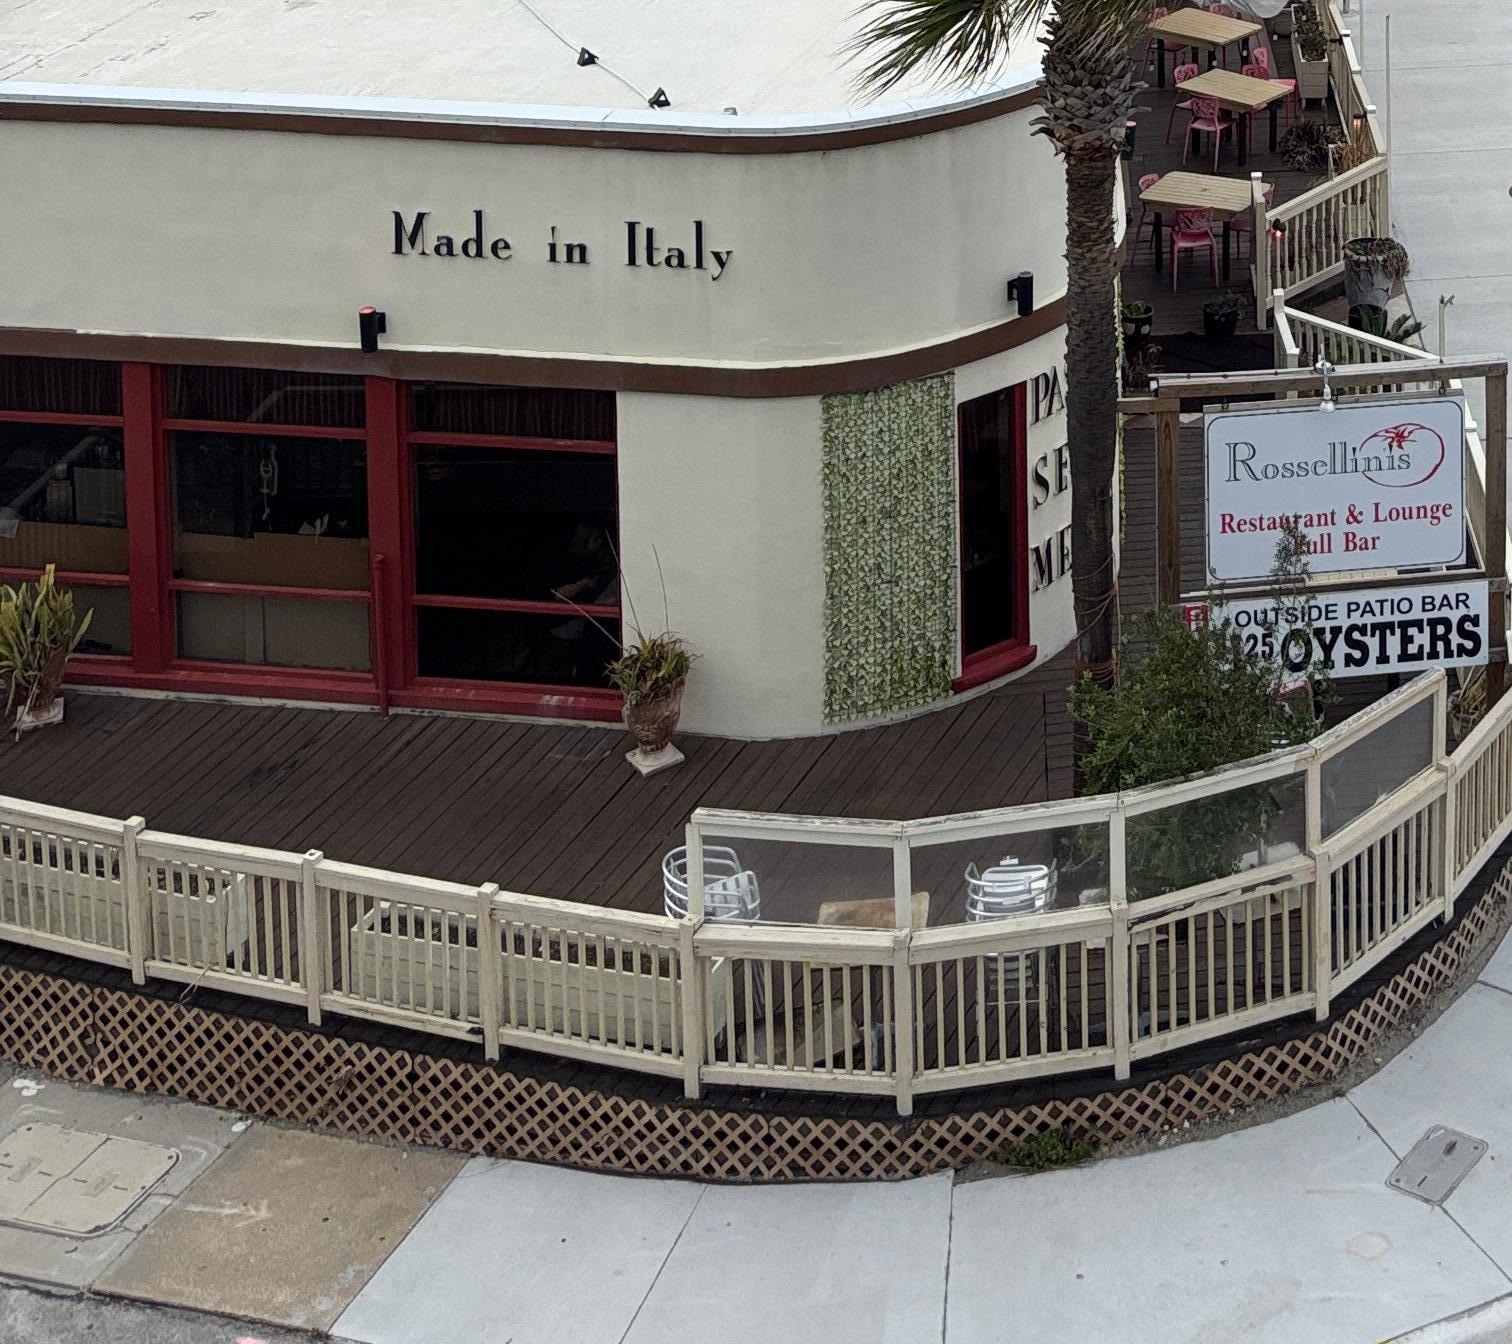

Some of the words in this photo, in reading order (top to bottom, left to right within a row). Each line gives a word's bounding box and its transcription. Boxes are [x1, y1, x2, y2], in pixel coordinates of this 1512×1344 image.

[392, 210, 513, 259] Made
[547, 226, 591, 264] in
[624, 220, 733, 281] Italy
[1220, 509, 1337, 534] Restaurant
[1346, 503, 1364, 525] &
[1373, 501, 1453, 526] Lounge
[1343, 531, 1381, 553] Bar
[1234, 602, 1339, 628] OUTSIDE
[1346, 597, 1414, 620] PATIO
[1421, 592, 1471, 613] BAR
[1280, 614, 1483, 673] OYSTERS
